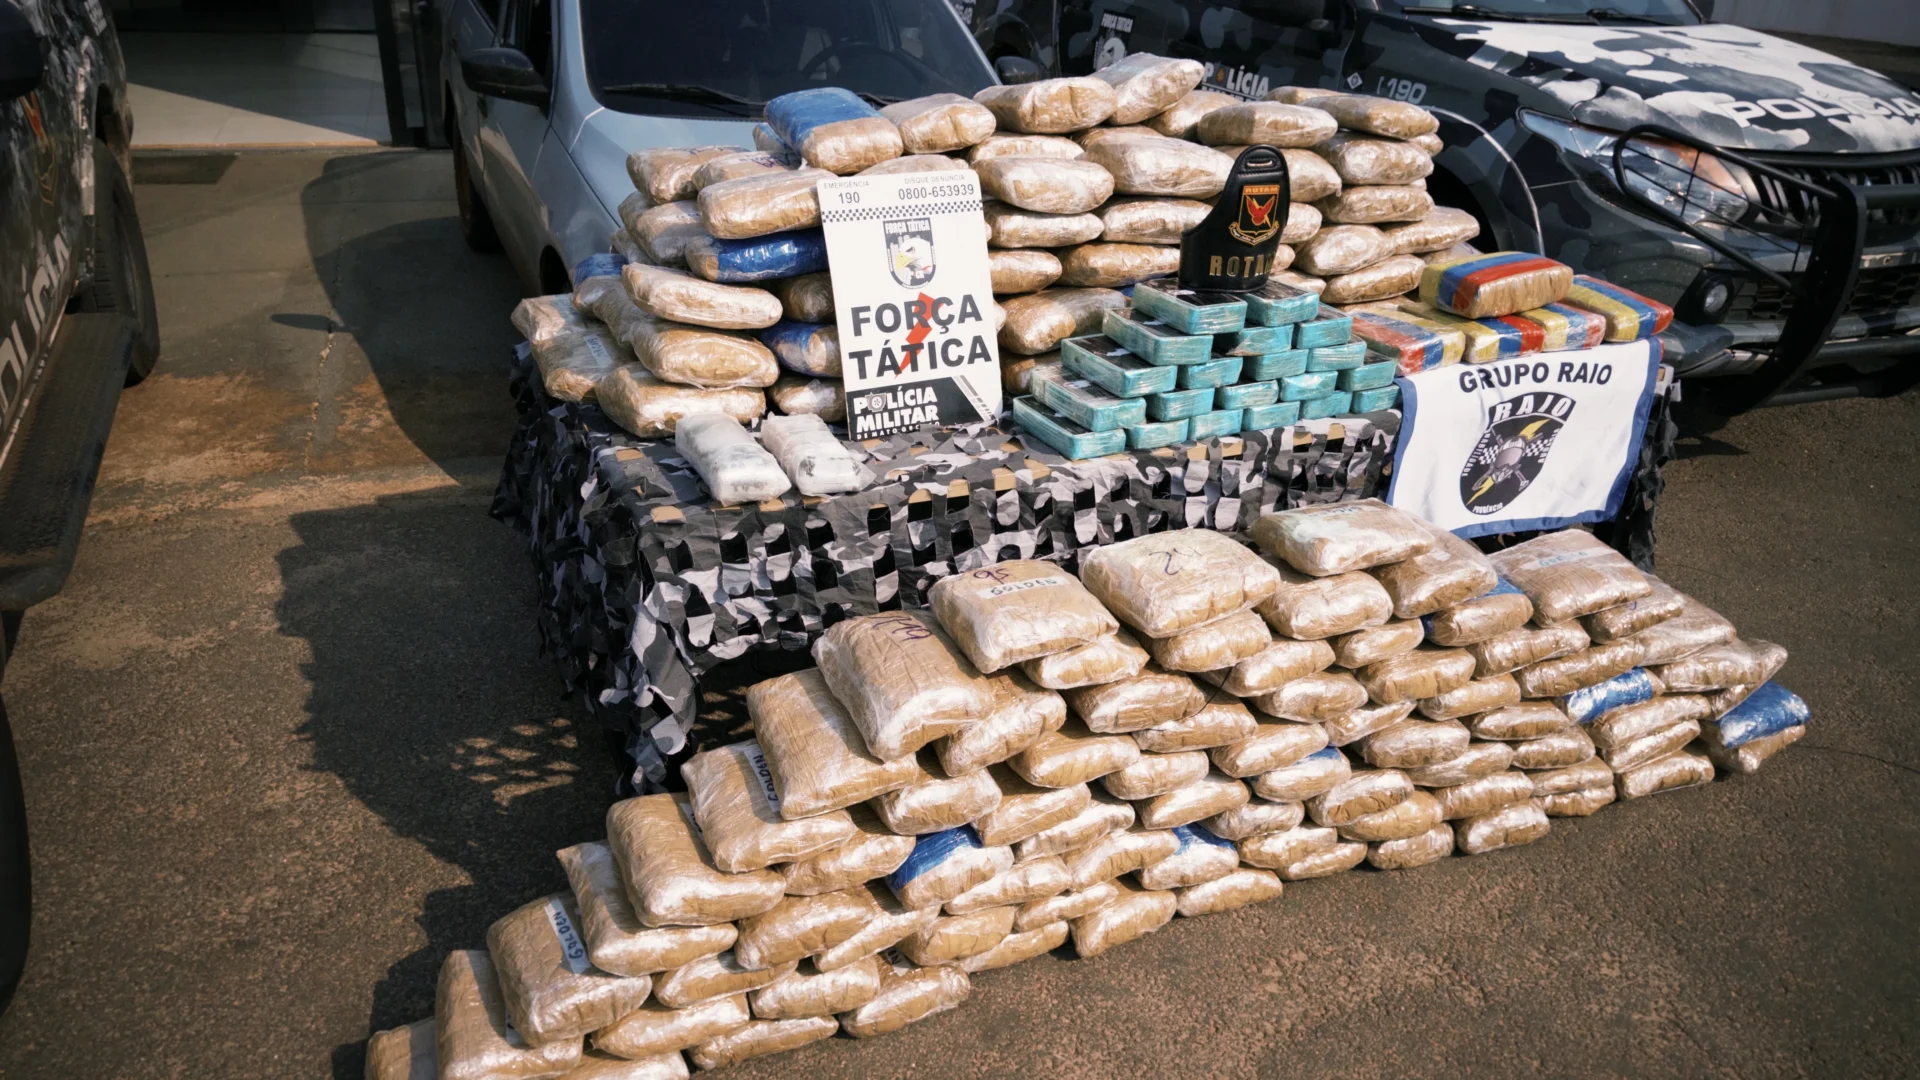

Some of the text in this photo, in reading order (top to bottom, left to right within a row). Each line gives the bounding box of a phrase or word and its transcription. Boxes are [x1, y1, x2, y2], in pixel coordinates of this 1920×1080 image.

[1387, 78, 1427, 105] 190
[898, 184, 974, 201] 0800-653939
[904, 176, 929, 185] DISQUE
[838, 192, 860, 204] 190
[851, 294, 983, 337] FORÇA
[848, 335, 992, 380] TÁTICA
[1459, 362, 1612, 393] GRUPO RAIO
[856, 405, 939, 433] MILITAR
[1493, 394, 1572, 423] RAIO
[871, 429, 898, 437] MATO
